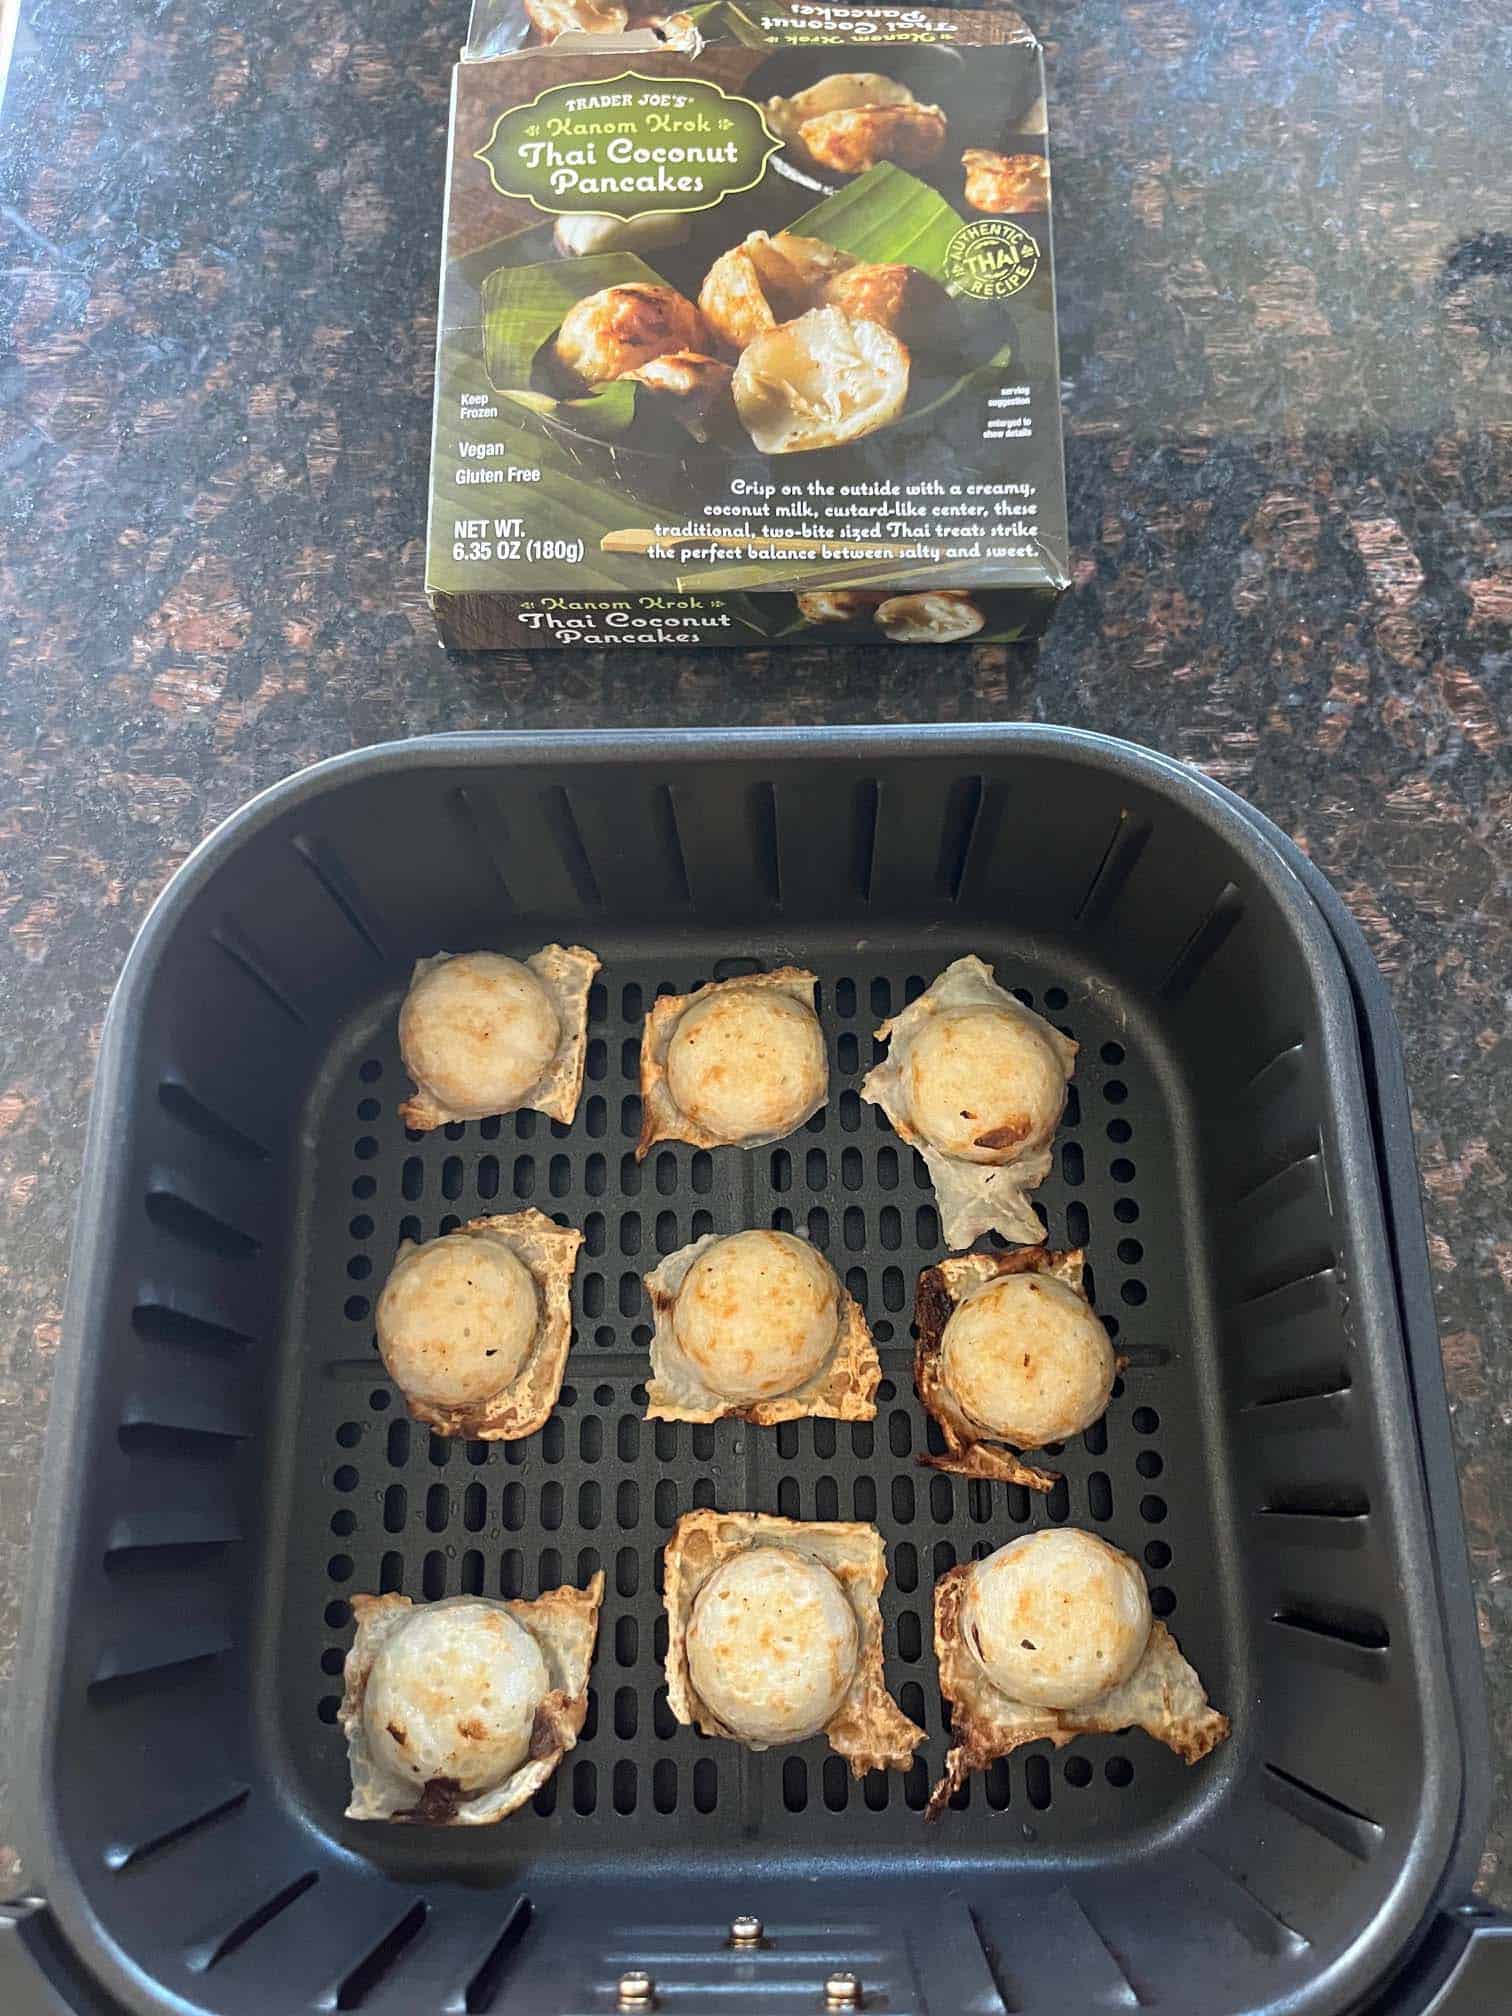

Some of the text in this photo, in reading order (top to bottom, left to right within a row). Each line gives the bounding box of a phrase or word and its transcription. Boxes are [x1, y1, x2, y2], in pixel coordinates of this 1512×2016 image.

[791, 4, 926, 22] Pancakes
[761, 17, 958, 34] Thai Coconut
[784, 33, 935, 44] Kanom Krok
[565, 94, 687, 112] TRADER JOE'S
[546, 113, 711, 136] Kanom Krok
[518, 138, 738, 168] Thai Coconut
[550, 165, 704, 195] Pancakes
[950, 223, 1023, 260] AUTHENTIC
[963, 245, 1020, 276] THAI
[971, 266, 1030, 296] RECIPE
[461, 393, 489, 406] Keep
[460, 406, 497, 420] Frozen
[459, 441, 504, 459] Vegan
[455, 466, 541, 485] Gluten Free
[730, 479, 1036, 499] Crisp on the outside with a creamy,
[703, 500, 1038, 519] coconut milk, custard-like center, these
[454, 518, 526, 538] NET WT.
[654, 521, 1039, 542] traditional, two-bite sized Thai treats strike
[453, 538, 584, 563] 6.35 OZ (180g)
[647, 542, 1039, 563] the perfect balance between salty and sweet.
[540, 597, 703, 610] Kanom Krok
[518, 612, 731, 629] Thai Coconut
[555, 629, 700, 644] Pancakes
